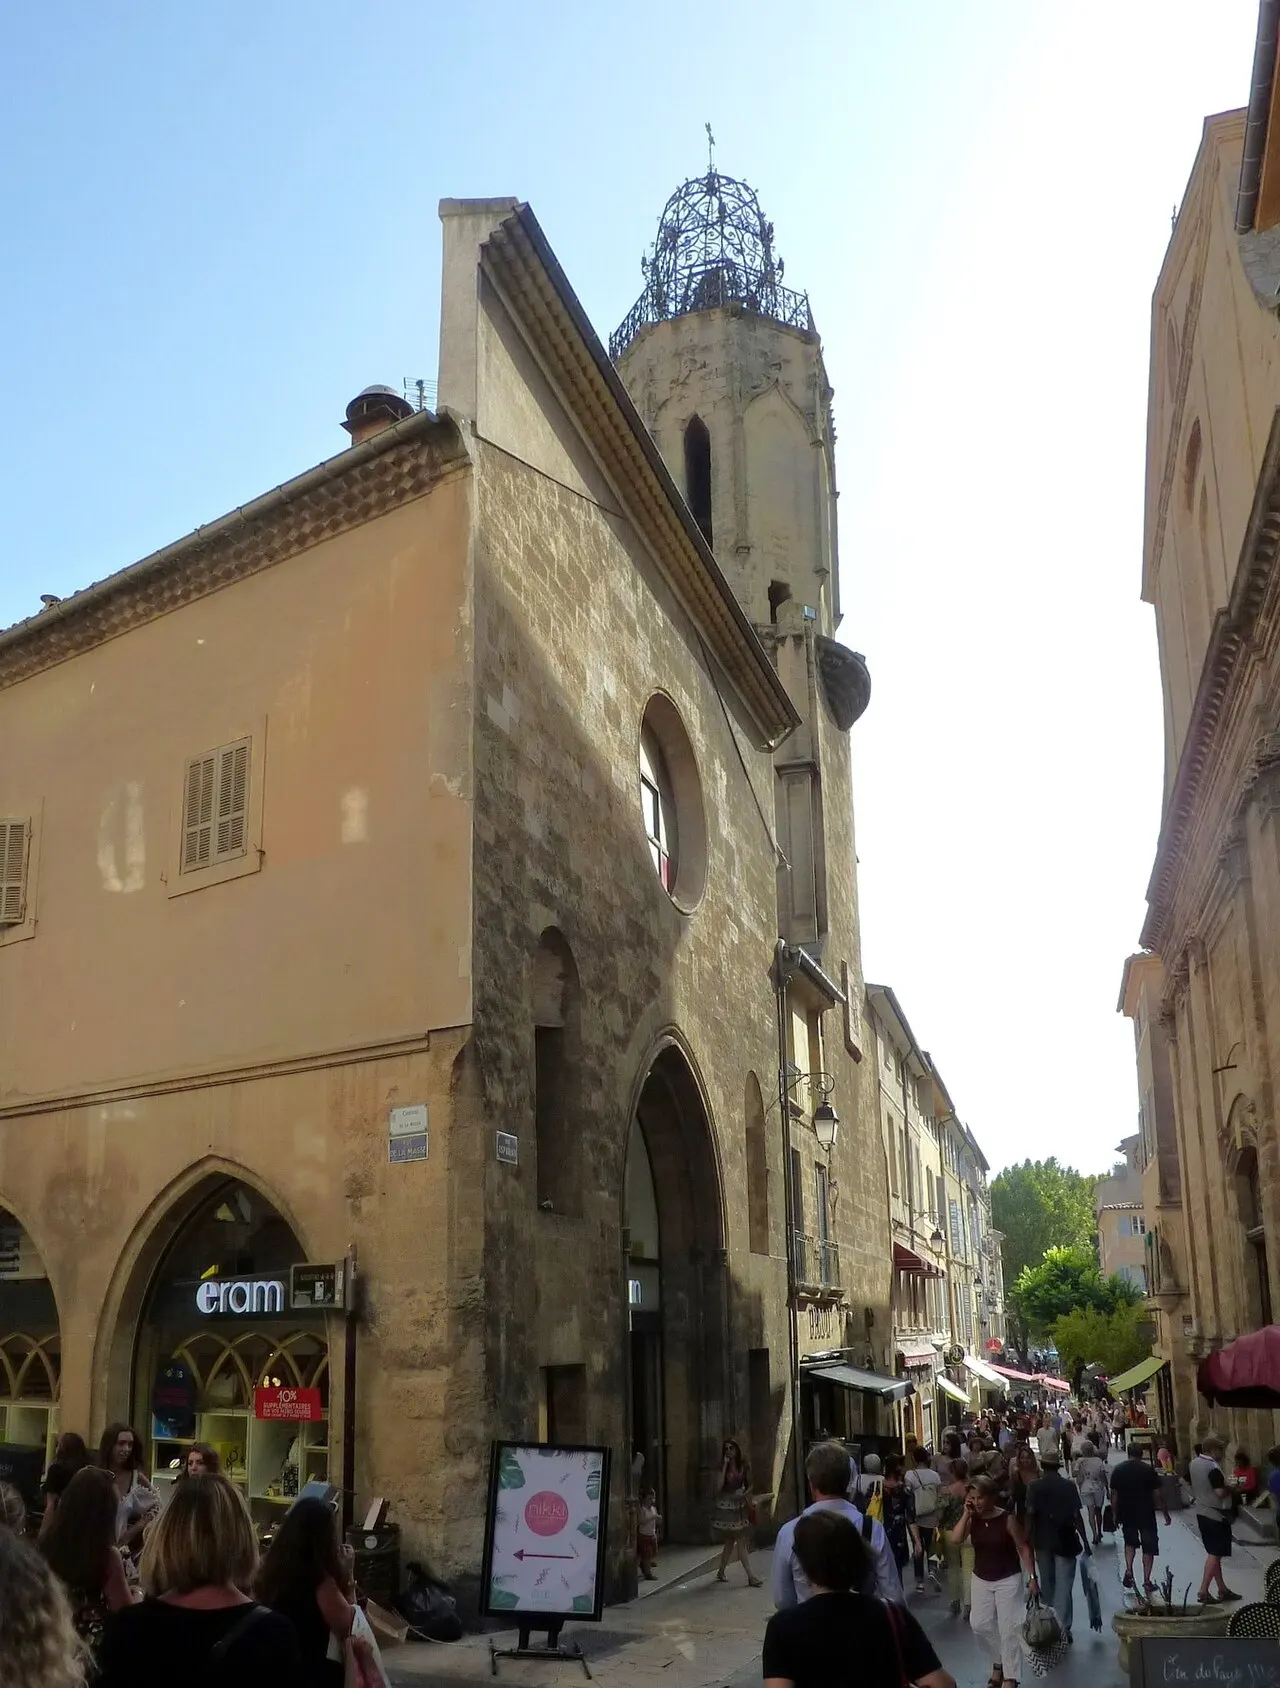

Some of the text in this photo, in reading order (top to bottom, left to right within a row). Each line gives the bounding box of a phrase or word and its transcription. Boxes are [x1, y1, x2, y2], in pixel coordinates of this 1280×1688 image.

[398, 1148, 406, 1157] LA
[196, 1265, 285, 1314] éram
[528, 1501, 565, 1517] nikki
